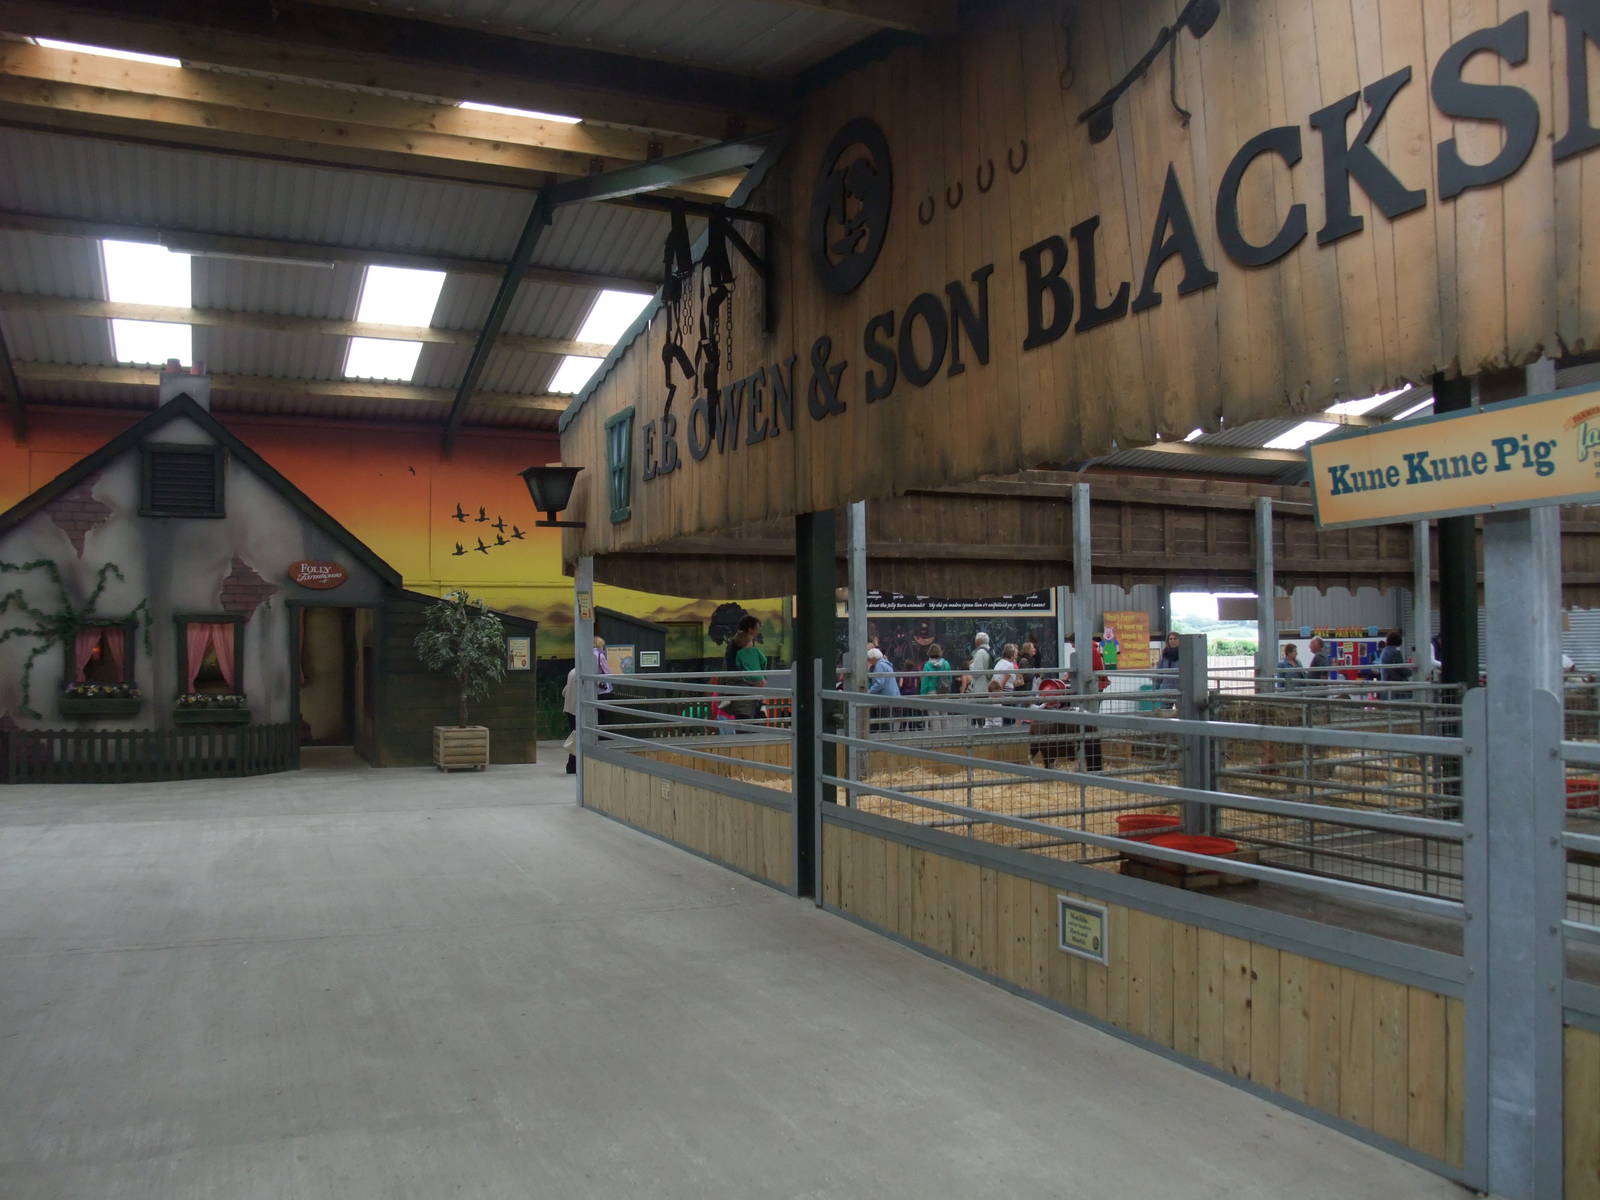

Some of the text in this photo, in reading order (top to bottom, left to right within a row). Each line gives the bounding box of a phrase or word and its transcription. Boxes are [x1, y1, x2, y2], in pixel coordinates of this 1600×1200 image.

[687, 354, 797, 461] OWEN
[807, 336, 848, 421] &
[864, 263, 993, 402] SON
[1328, 464, 1400, 496] Kune
[1403, 450, 1488, 485] Kune
[1491, 434, 1557, 477] Pig
